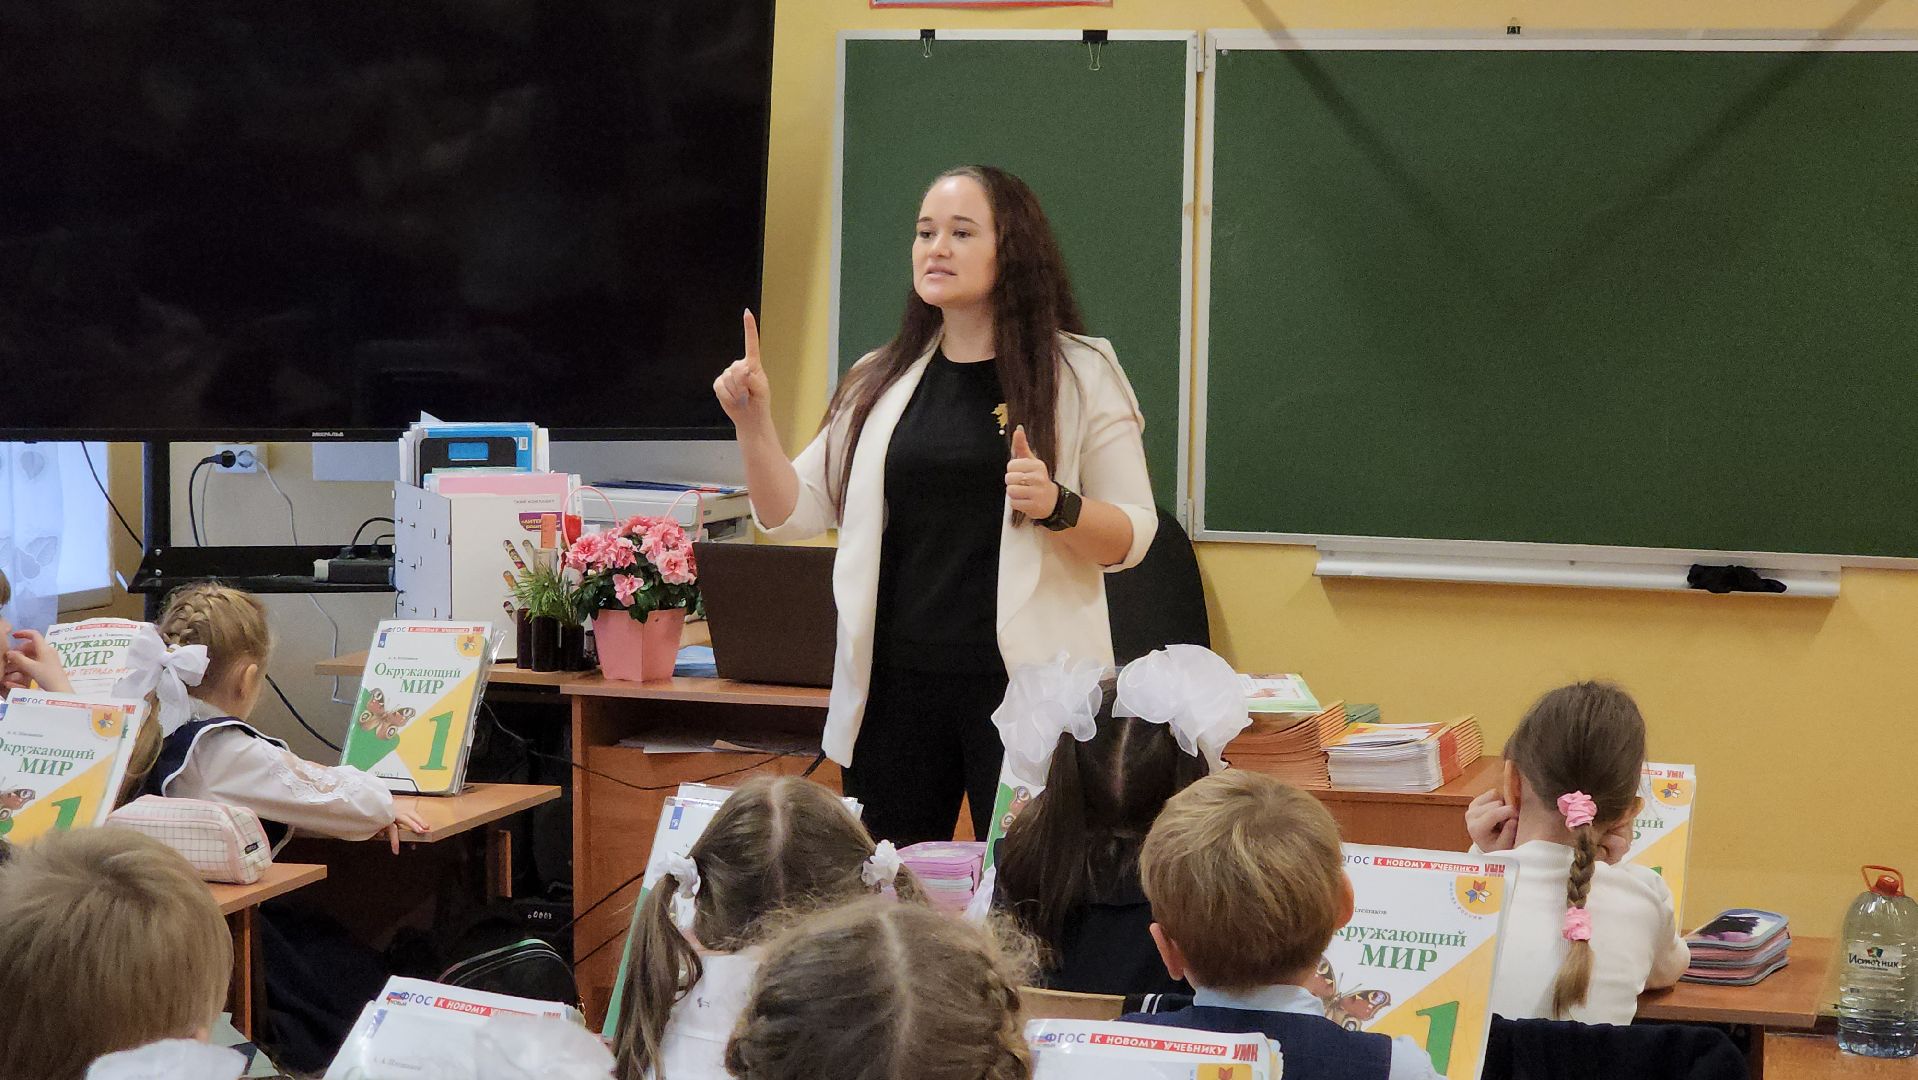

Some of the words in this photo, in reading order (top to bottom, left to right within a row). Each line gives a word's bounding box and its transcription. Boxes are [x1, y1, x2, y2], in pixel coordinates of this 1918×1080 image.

[63, 650, 114, 668] МИР
[374, 662, 461, 679] Окружающий
[400, 679, 444, 694] МИР
[419, 711, 454, 770] 1
[17, 757, 74, 777] МИР
[1386, 859, 1426, 869] НОВОМУ
[1430, 862, 1478, 873] УЧЕБНИКУ
[1335, 925, 1467, 947] кружающий
[1358, 943, 1438, 972] МИР
[1848, 952, 1899, 968] Источник
[400, 991, 433, 1006] ФГОС
[445, 1000, 487, 1015] НОВОМУ
[1044, 1033, 1086, 1044] ФГОС
[1094, 1034, 1101, 1043] К
[1106, 1035, 1158, 1049] НОВОМУ
[1163, 1041, 1225, 1056] УЧЕБНИКУ
[1416, 1001, 1460, 1076] 1
[1231, 1043, 1259, 1062] УМК
